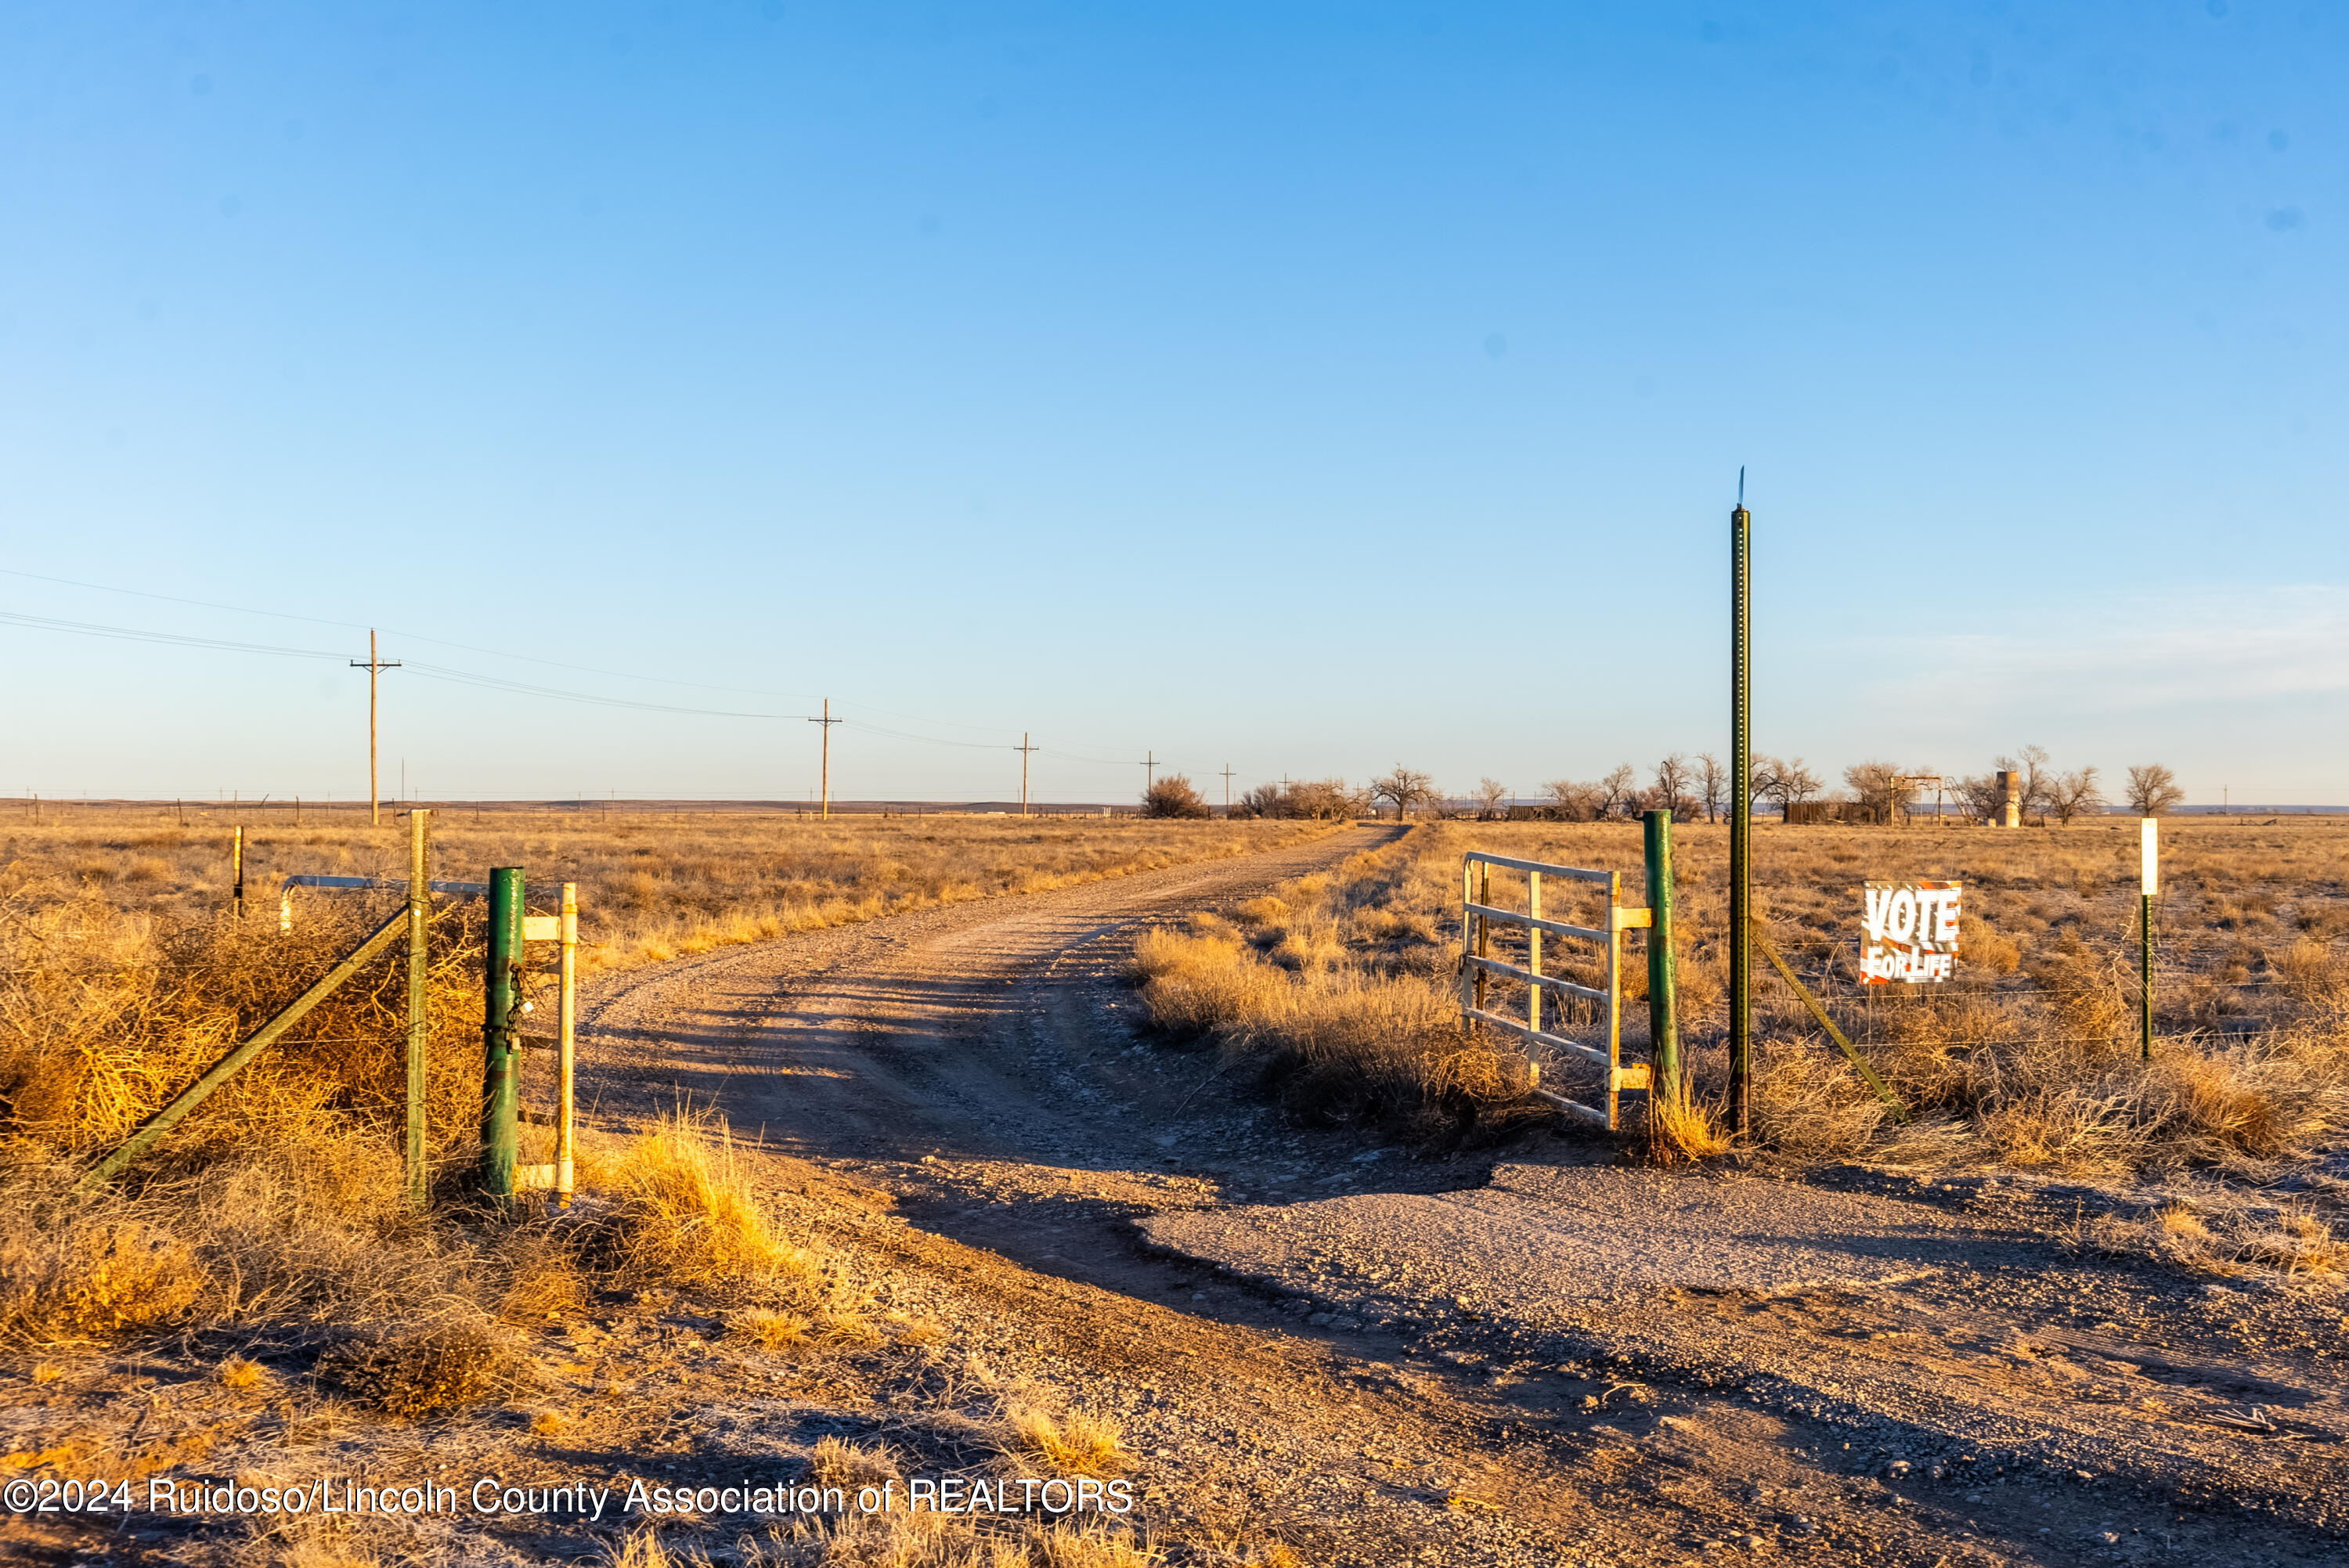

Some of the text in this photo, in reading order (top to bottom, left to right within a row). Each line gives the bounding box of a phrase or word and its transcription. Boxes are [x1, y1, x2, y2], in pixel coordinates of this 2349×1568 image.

[1865, 889, 1958, 943] VOTE
[1867, 946, 1952, 979] FOR LIFE
